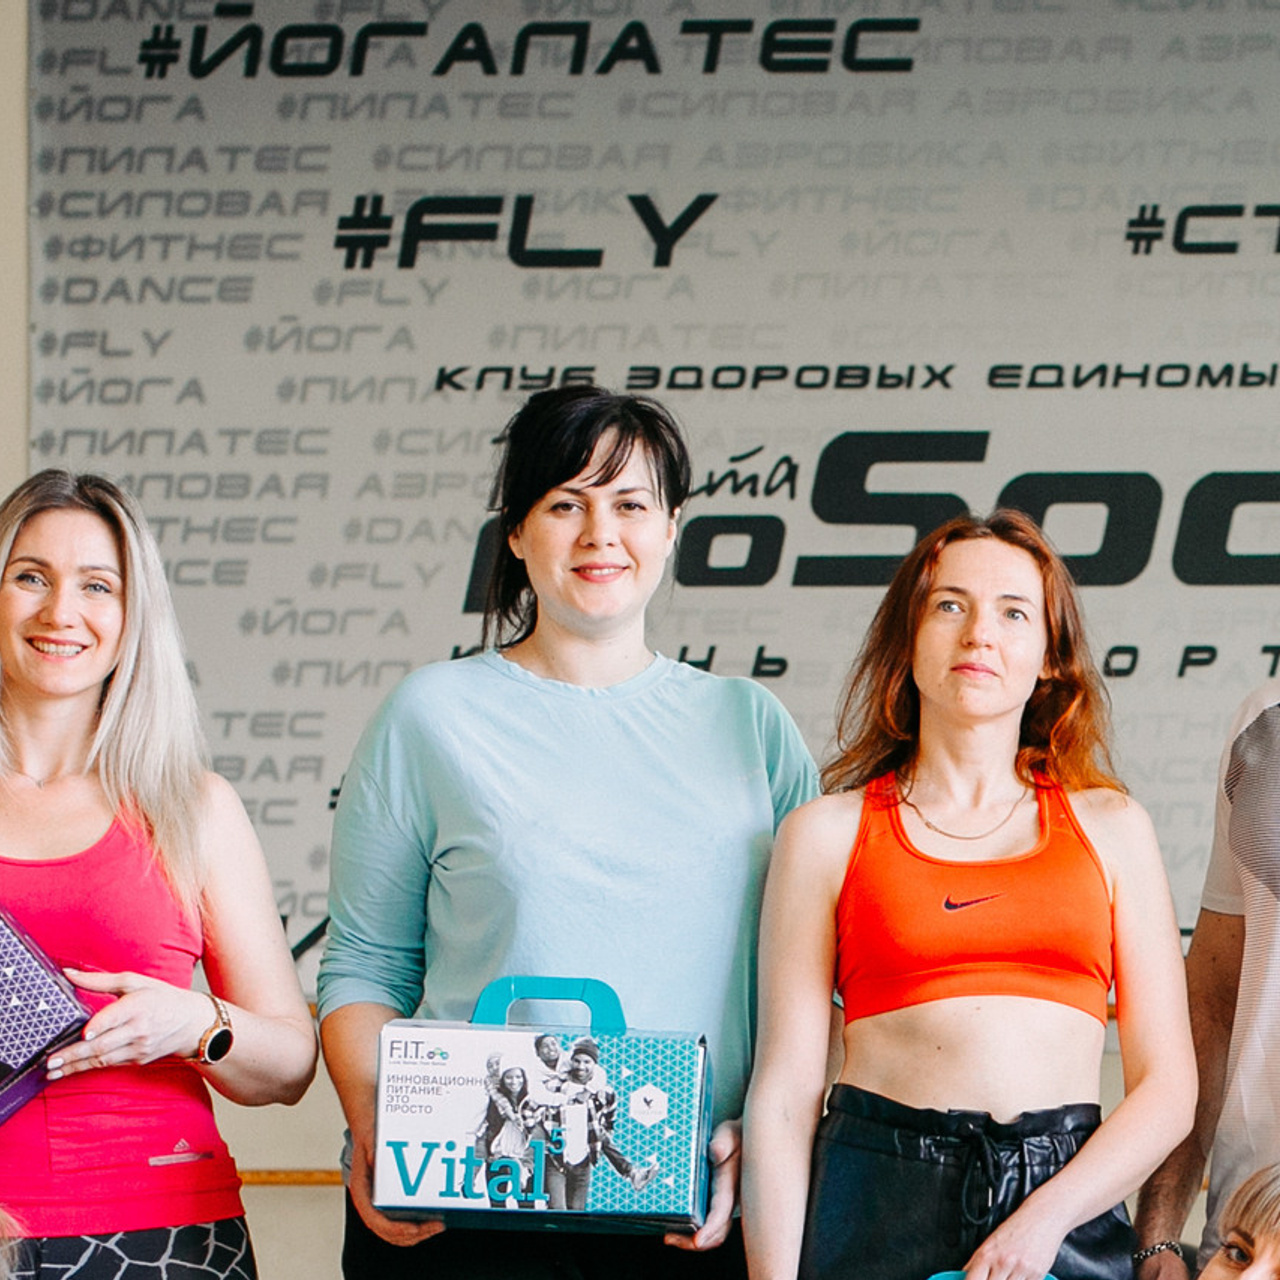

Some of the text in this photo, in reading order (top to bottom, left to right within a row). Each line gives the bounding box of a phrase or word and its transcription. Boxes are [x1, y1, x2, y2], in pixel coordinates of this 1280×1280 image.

[333, 192, 722, 271] #FLY
[39, 274, 256, 305] #DANCE
[37, 328, 174, 359] #FLY
[624, 363, 957, 392] ЗДОРОВЫХ
[308, 561, 444, 591] #FLY
[237, 596, 411, 638] #ЙОГА
[387, 1085, 442, 1097] ПИТАНИЕ
[387, 1095, 410, 1105] ЭТО
[386, 1104, 433, 1115] ПРОСТО
